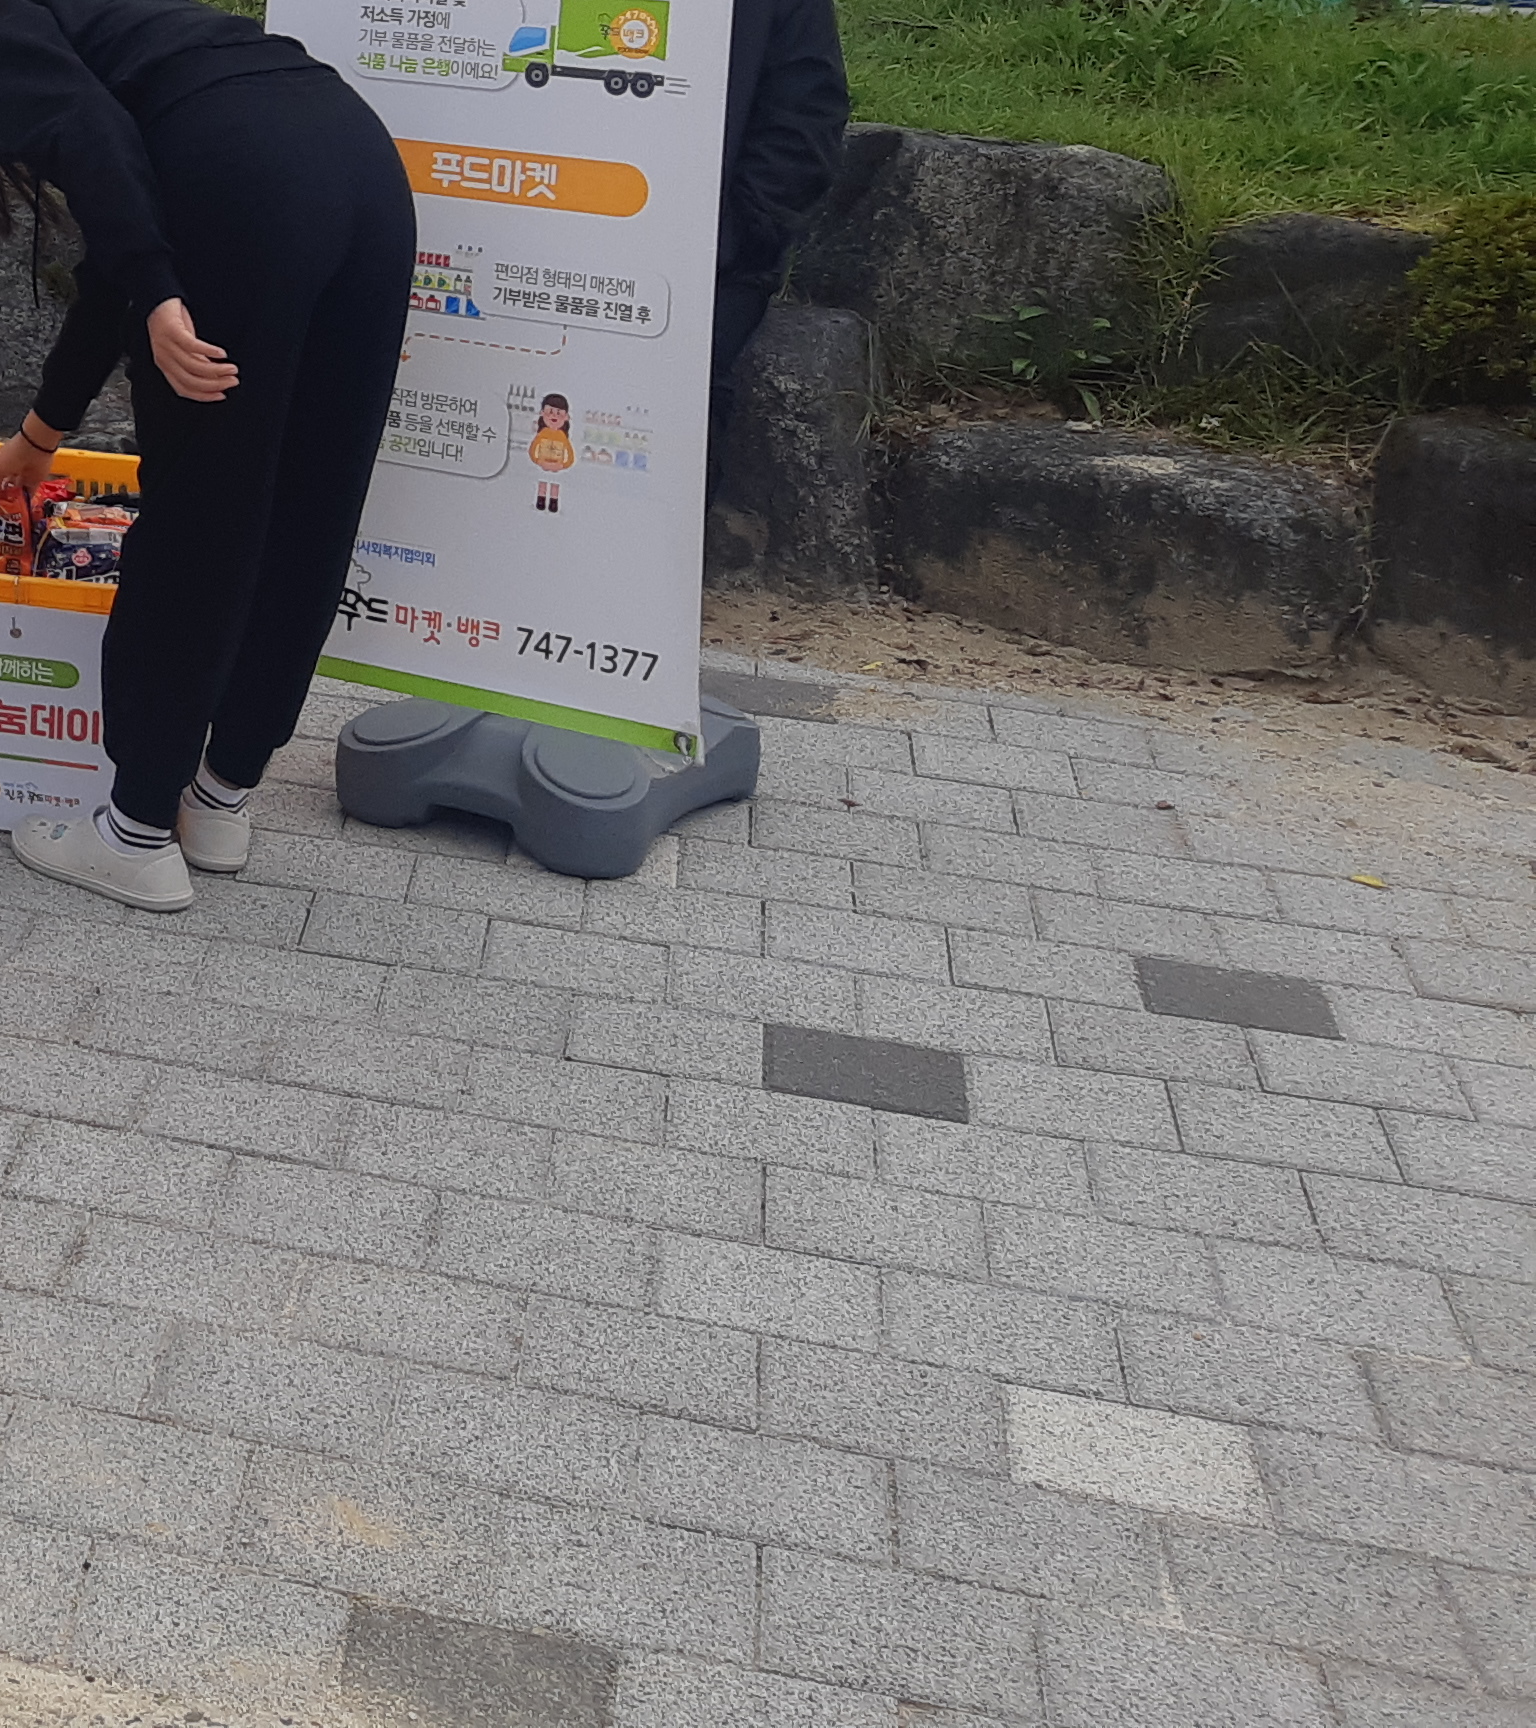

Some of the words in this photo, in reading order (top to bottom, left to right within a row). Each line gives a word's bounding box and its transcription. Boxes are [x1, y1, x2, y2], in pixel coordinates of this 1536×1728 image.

[360, 5, 404, 26] 저소득
[407, 9, 450, 30] 가정에
[358, 28, 388, 47] 기부
[391, 31, 436, 52] 물품을
[438, 37, 497, 58] 전달하는
[356, 52, 386, 70] 식품
[421, 58, 499, 81] 은행이에요!
[430, 151, 558, 201] 푸드마켓
[494, 262, 538, 284] 편의점
[542, 266, 587, 291] 형태의
[590, 274, 636, 298] 매장에
[492, 287, 551, 310] 기부받은
[553, 294, 601, 318] 물품을
[602, 300, 633, 322] 진열
[635, 305, 652, 325] 후
[420, 391, 478, 418] 방문하여
[403, 413, 433, 434] 등을
[435, 418, 480, 442] 선택할
[481, 426, 497, 443] 수
[389, 434, 464, 463] 공간입니다!
[516, 625, 660, 681] 747-1377
